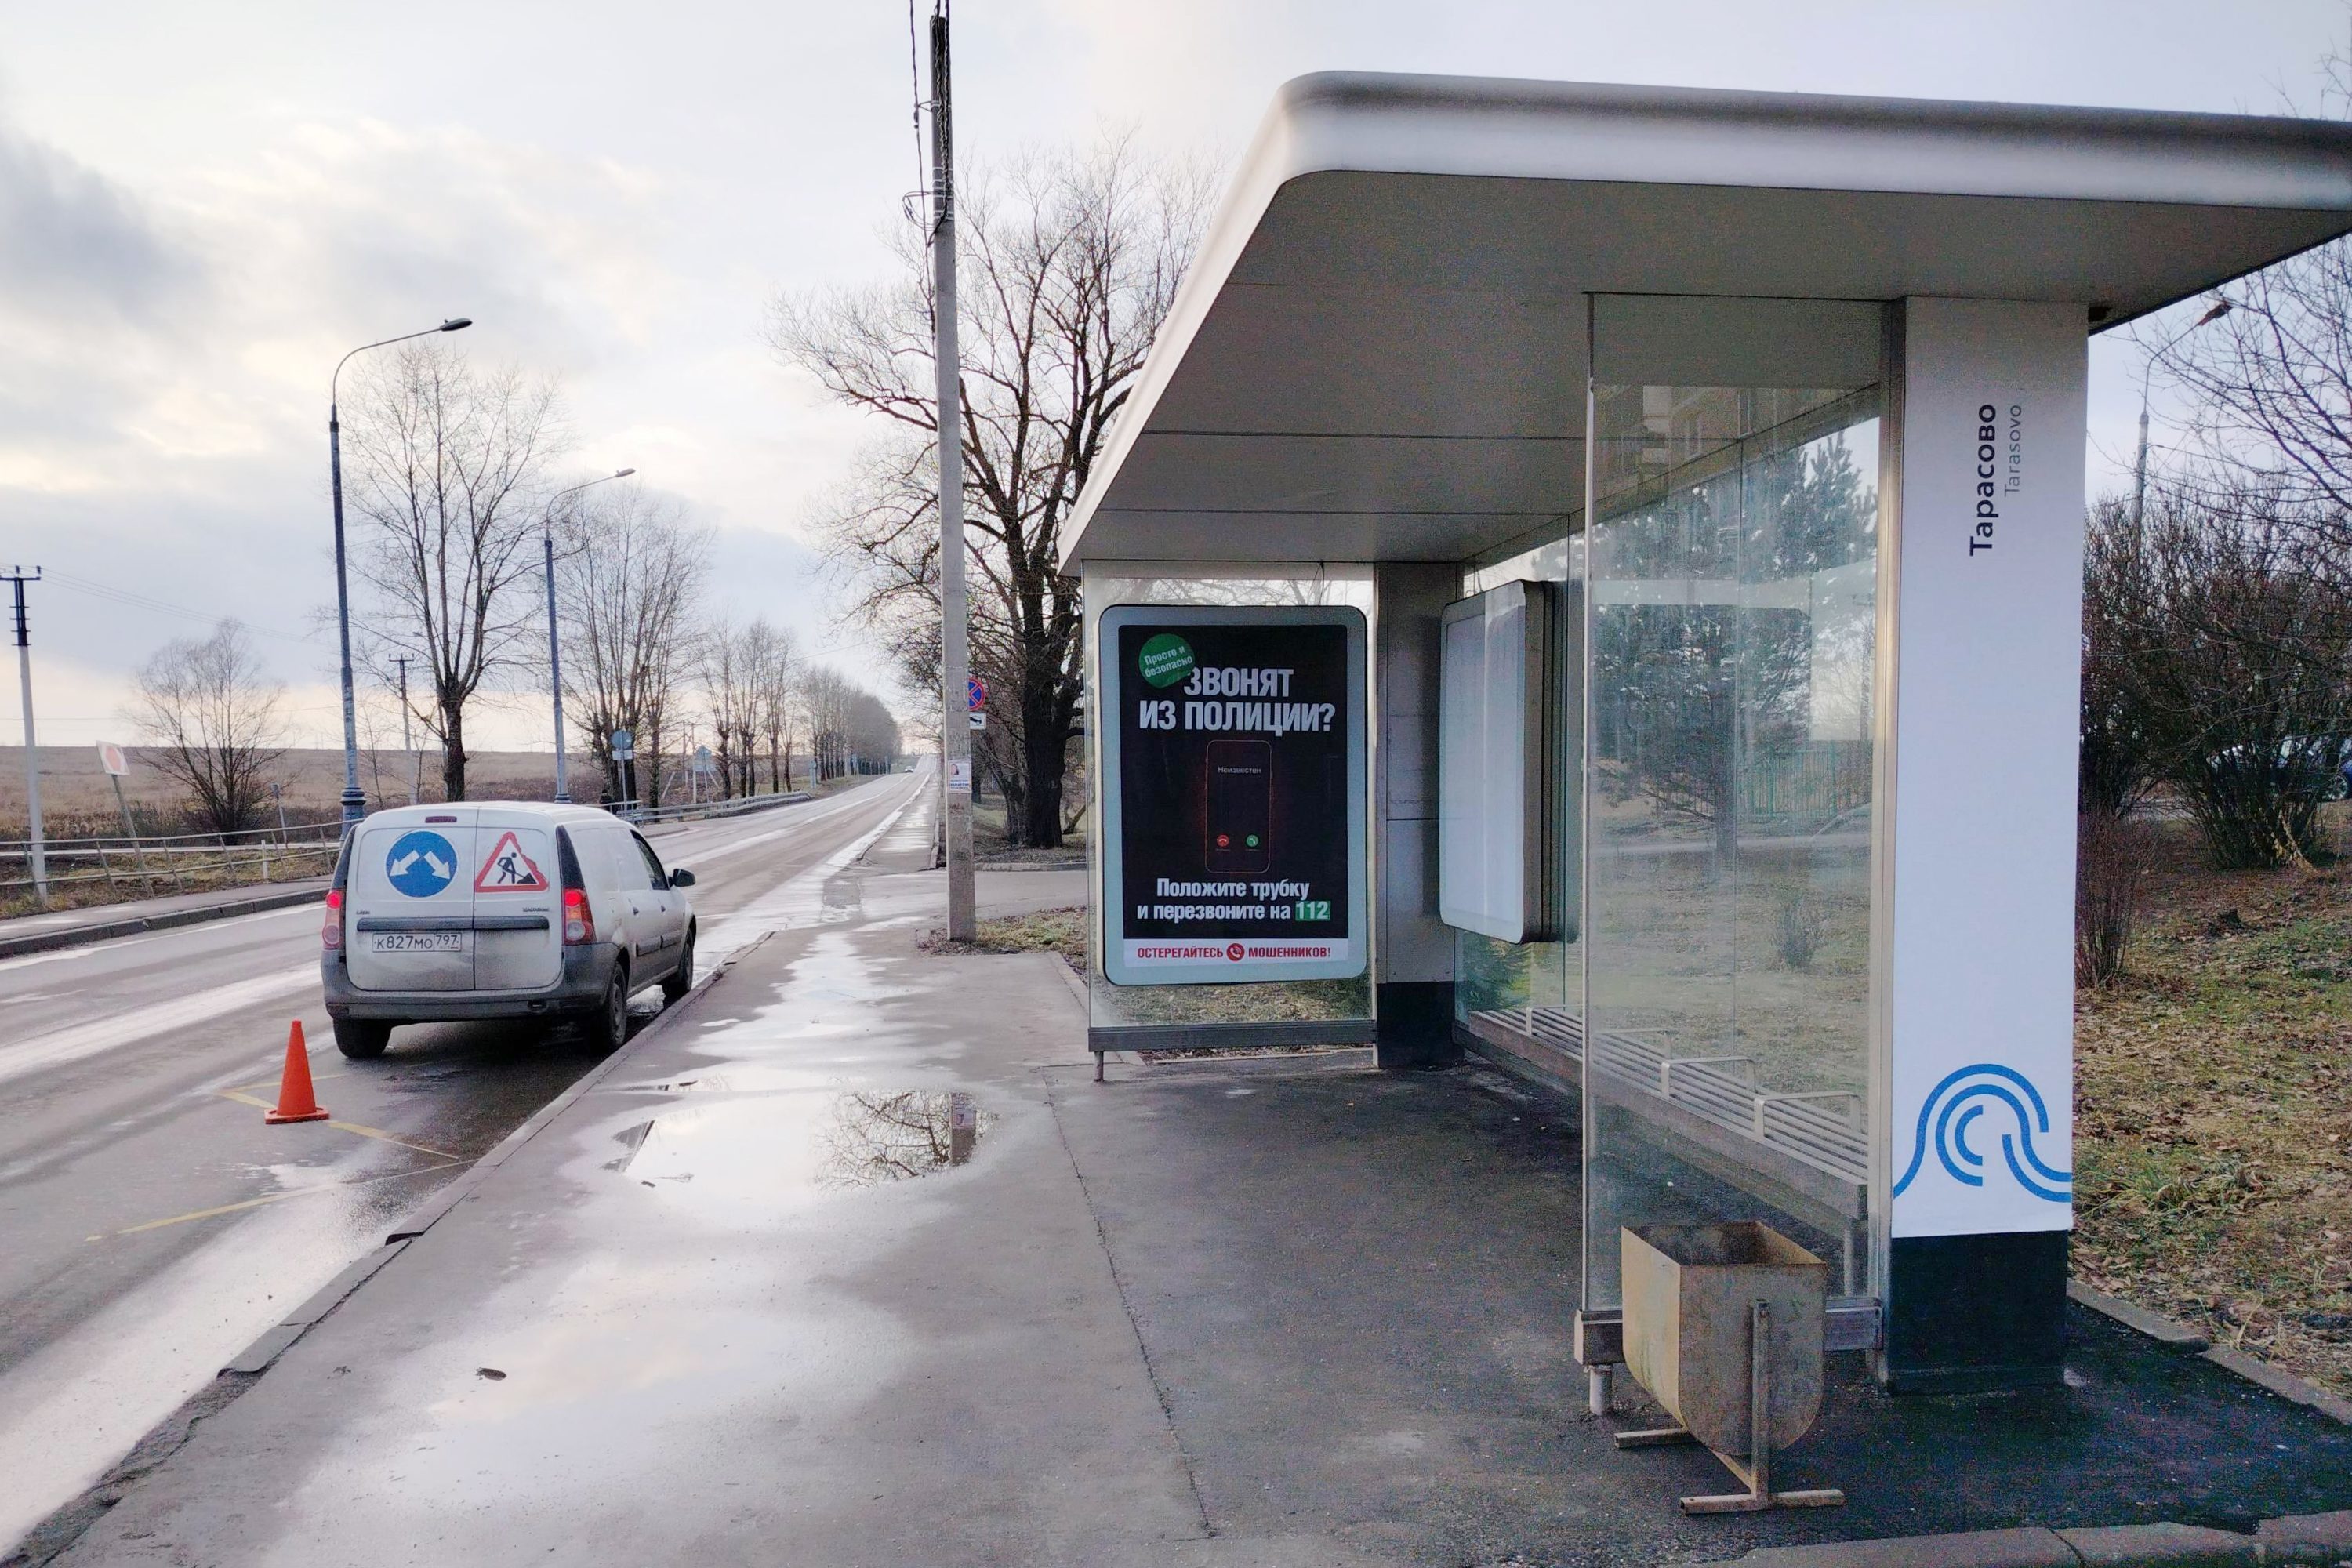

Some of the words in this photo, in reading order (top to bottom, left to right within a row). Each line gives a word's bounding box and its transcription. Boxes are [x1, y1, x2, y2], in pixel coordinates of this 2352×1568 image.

[2005, 405, 2022, 497] Tarasovo
[1969, 405, 1998, 557] Тарасово
[1144, 648, 1177, 666] Просто
[1178, 645, 1186, 655] и
[1145, 655, 1193, 678] безопасно
[1184, 667, 1294, 697] ЗВОНЯТ
[1139, 700, 1177, 730] ИЗ
[1185, 701, 1336, 737] ПОЛИЦИИ?
[1156, 878, 1247, 897] Положите
[1250, 879, 1310, 901] трубку
[1137, 906, 1149, 920] и
[1153, 904, 1265, 924] перезвоните
[1270, 906, 1291, 920] на
[1296, 901, 1329, 920] 112
[1138, 946, 1223, 959] ОСТЕРЕГАЙТЕСЬ
[1248, 946, 1331, 958] МОШЕННИКОВ!
